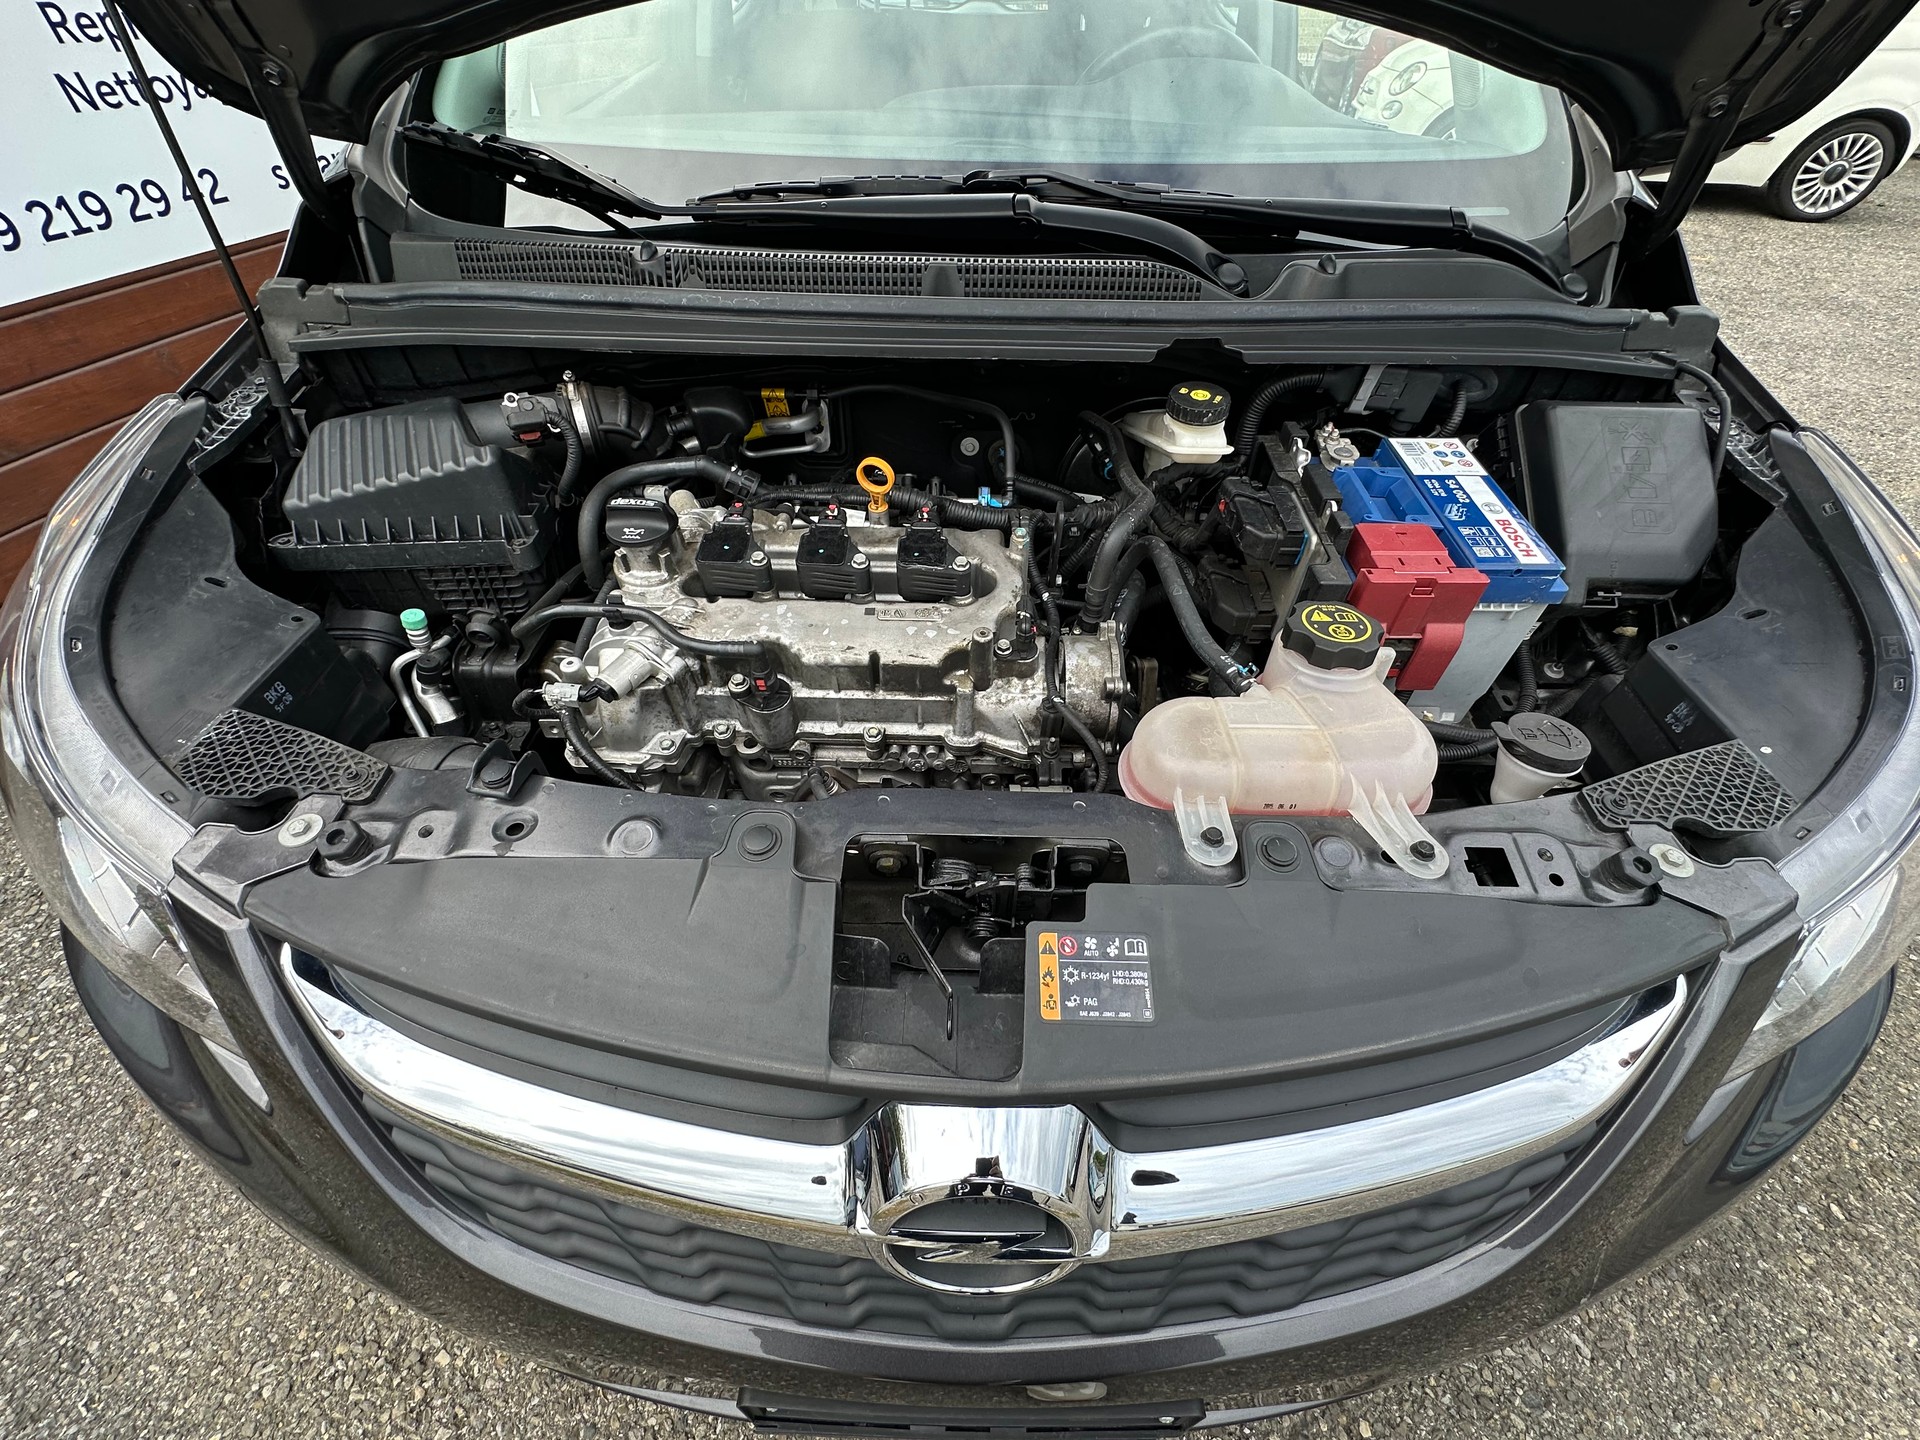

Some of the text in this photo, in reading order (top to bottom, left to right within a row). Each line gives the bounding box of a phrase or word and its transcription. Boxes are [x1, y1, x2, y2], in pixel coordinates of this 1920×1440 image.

[24, 190, 113, 243] 219
[115, 178, 172, 224] 29
[610, 497, 659, 507] dexos
[1452, 489, 1470, 503] 002
[1494, 519, 1538, 558] BOSCH
[263, 681, 286, 705] BKB
[1083, 949, 1099, 957] AUTO
[1081, 972, 1110, 982] R-1234yf
[1083, 998, 1098, 1006] PAG
[908, 1182, 1052, 1210] OPEL
